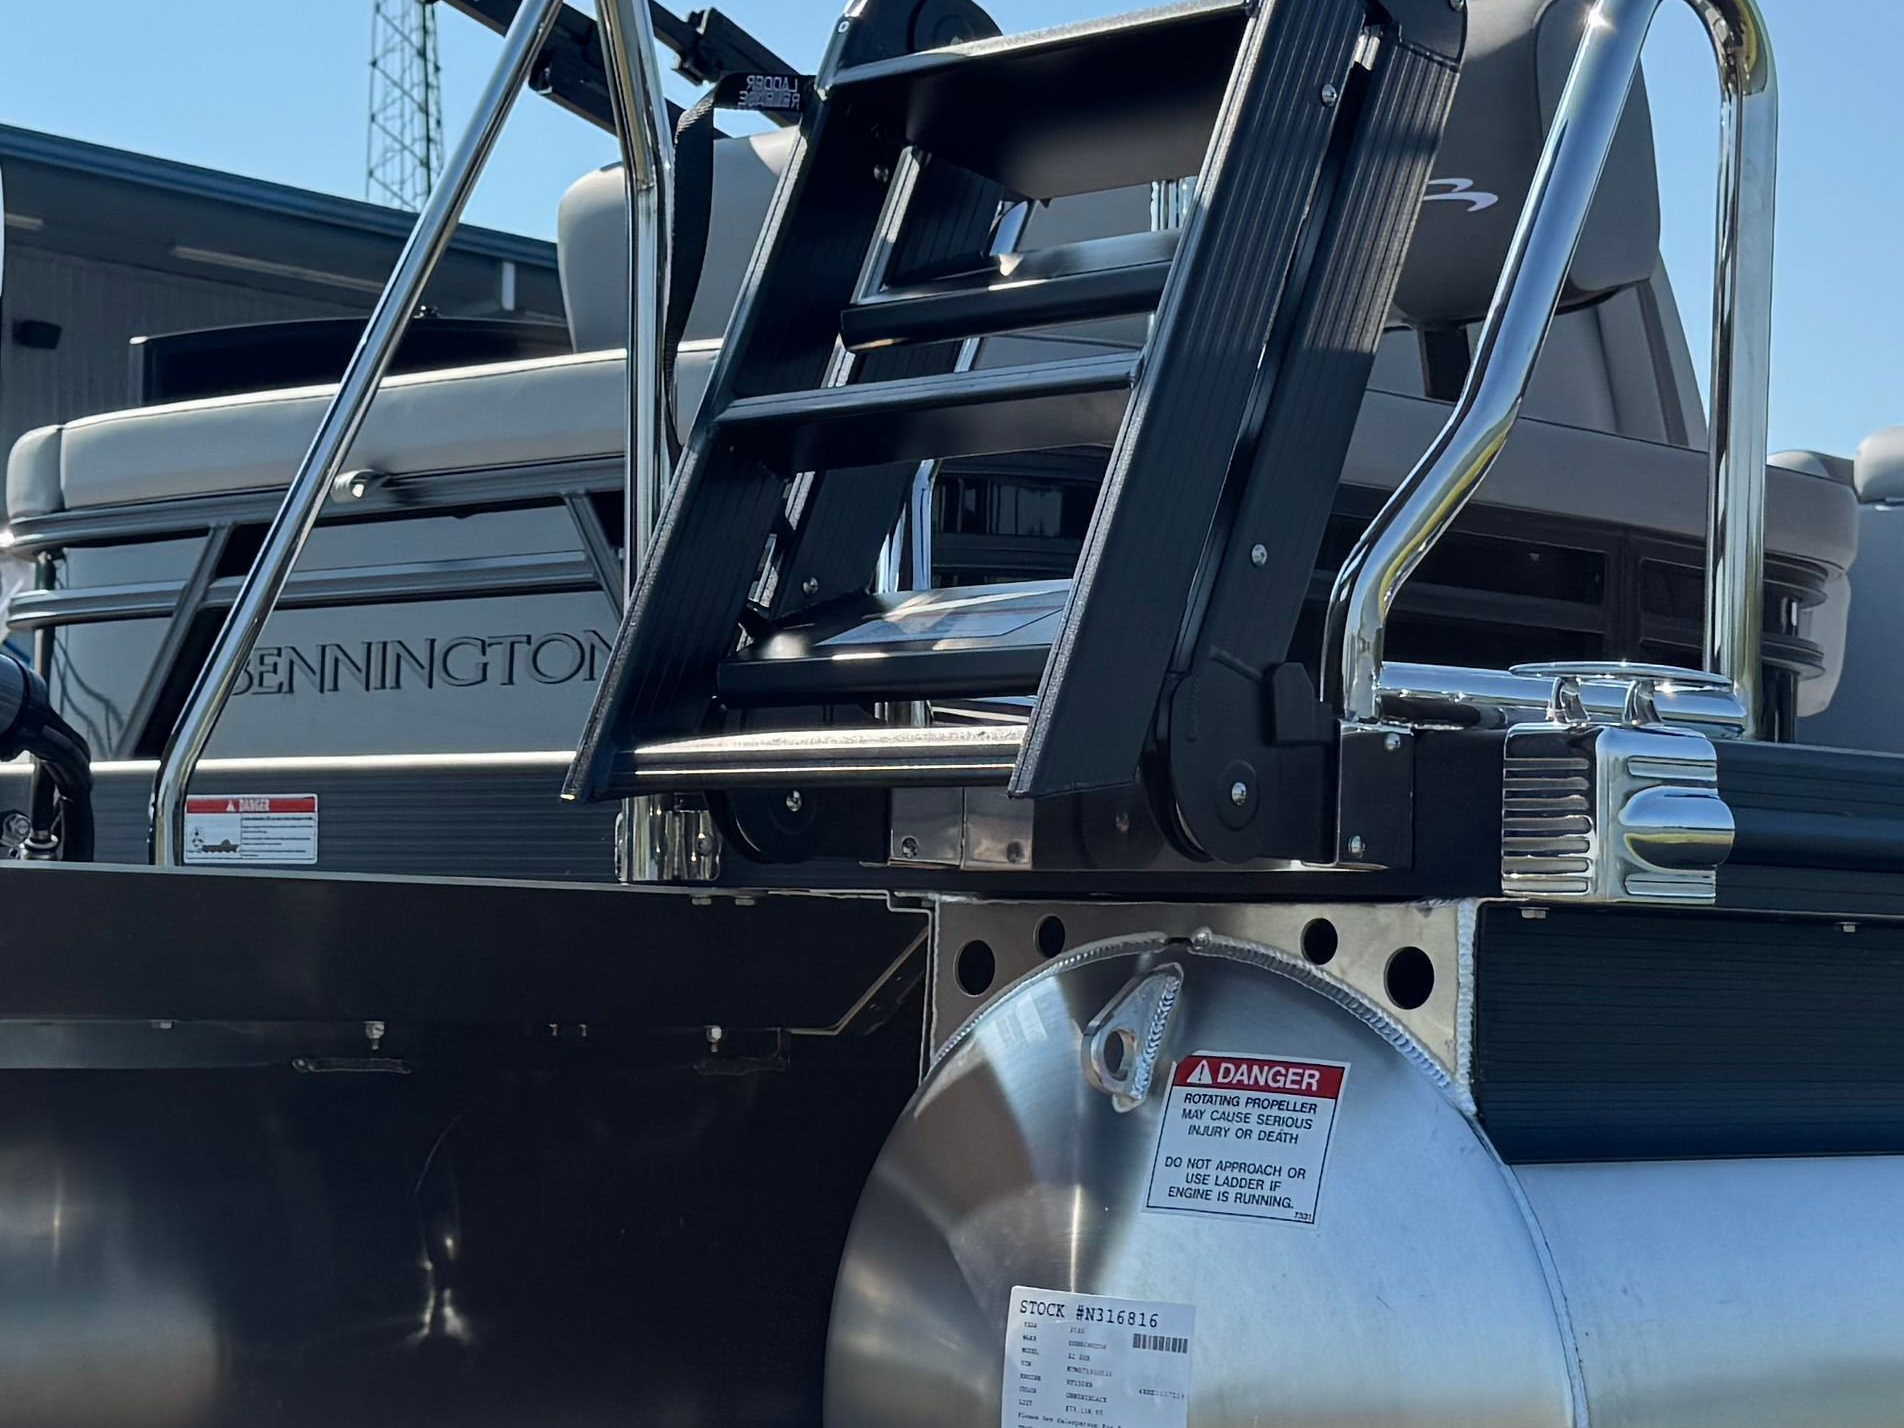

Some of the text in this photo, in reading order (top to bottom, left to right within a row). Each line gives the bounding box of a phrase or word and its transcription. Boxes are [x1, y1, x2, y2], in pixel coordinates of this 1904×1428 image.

[1217, 1062, 1320, 1091] DANGER
[1184, 1092, 1317, 1114] ROTATING PROPELLER
[1181, 1108, 1313, 1130] MAY CAUSE SERIOUS
[1188, 1124, 1298, 1144] INJURY OR DEATH
[1164, 1156, 1306, 1179] DO NOT APPROACH OR
[1185, 1173, 1282, 1191] USE LADDER IF
[1168, 1186, 1294, 1209] ENGINE IS RUNNING.
[1020, 1300, 1159, 1328] STOCK #N316816
